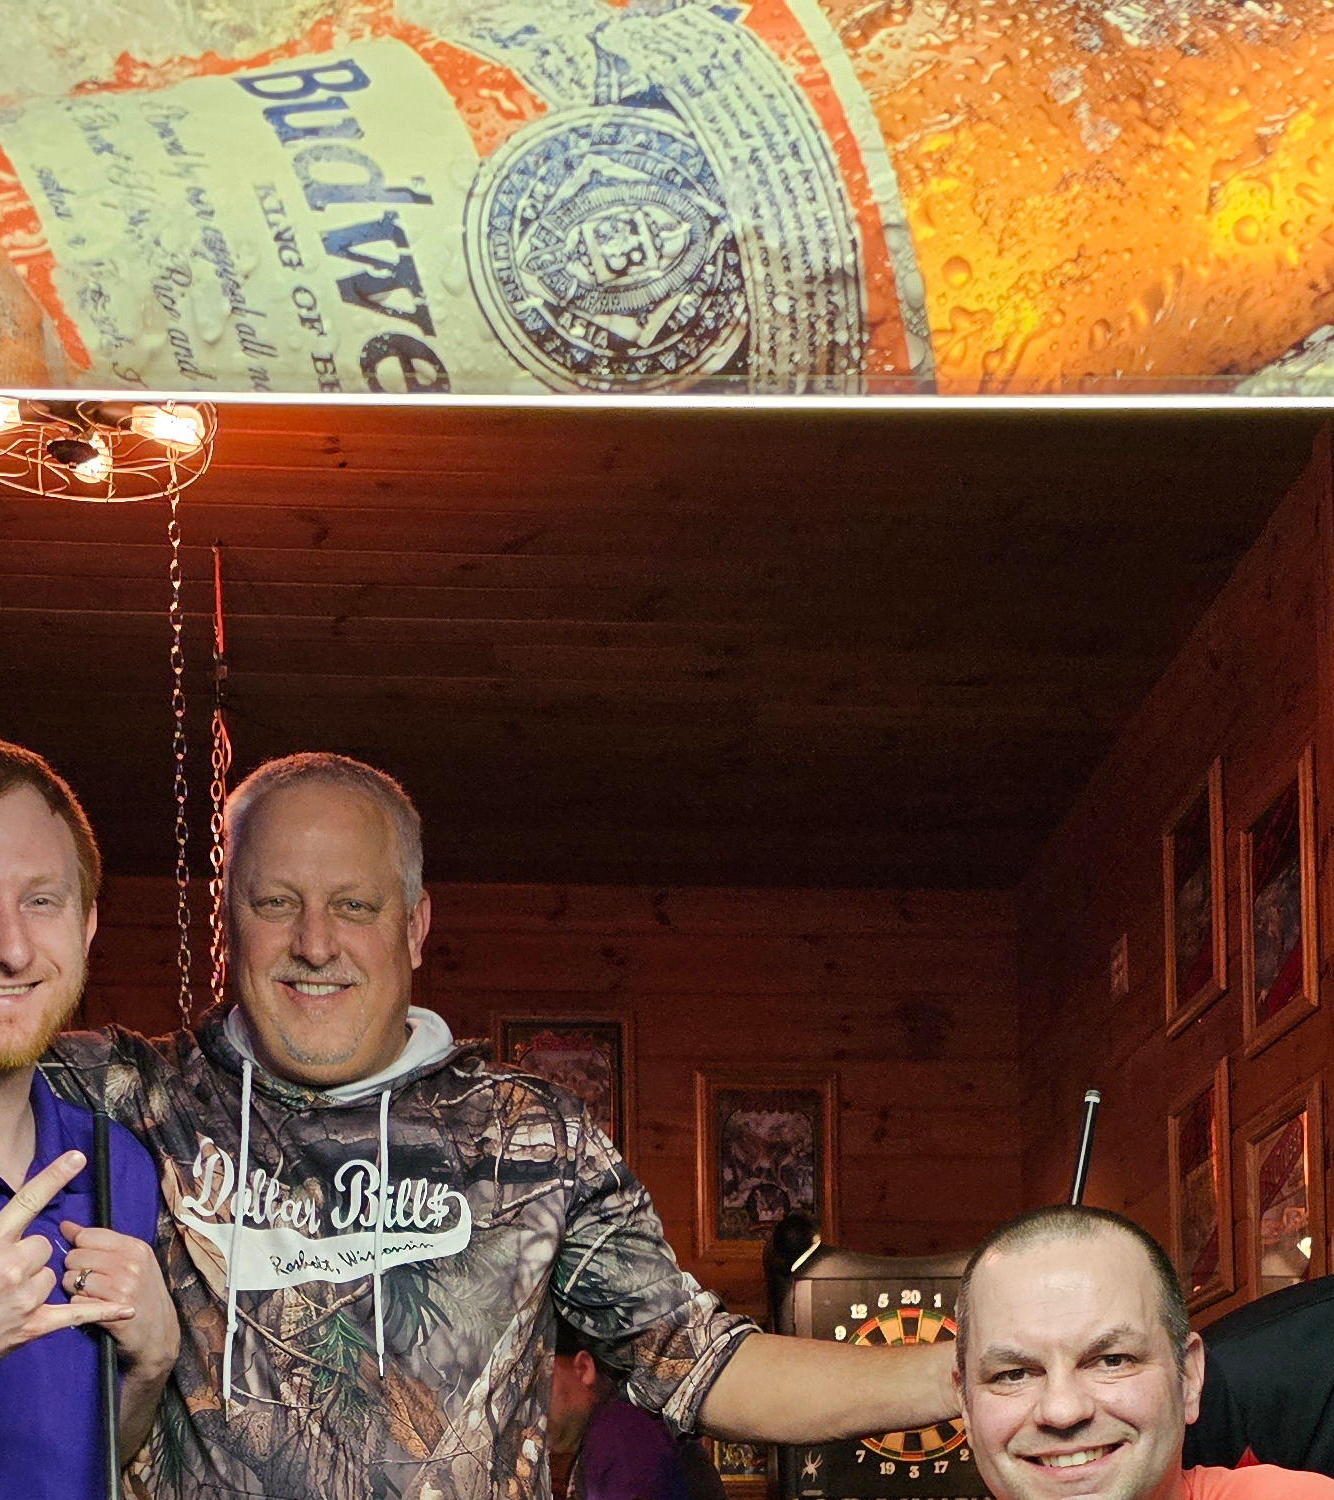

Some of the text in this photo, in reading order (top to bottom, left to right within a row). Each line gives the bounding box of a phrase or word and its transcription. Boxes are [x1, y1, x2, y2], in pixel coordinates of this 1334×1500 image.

[255, 182, 304, 272] KING
[292, 286, 328, 338] OF
[151, 252, 218, 383] Rice and
[556, 311, 609, 349] ASIA
[235, 321, 279, 359] all
[337, 1240, 434, 1267] Wisonsin
[850, 1289, 942, 1319] 12 5 20 1
[835, 1325, 846, 1340] 9
[855, 1449, 969, 1478] 7 19 3 17 2
